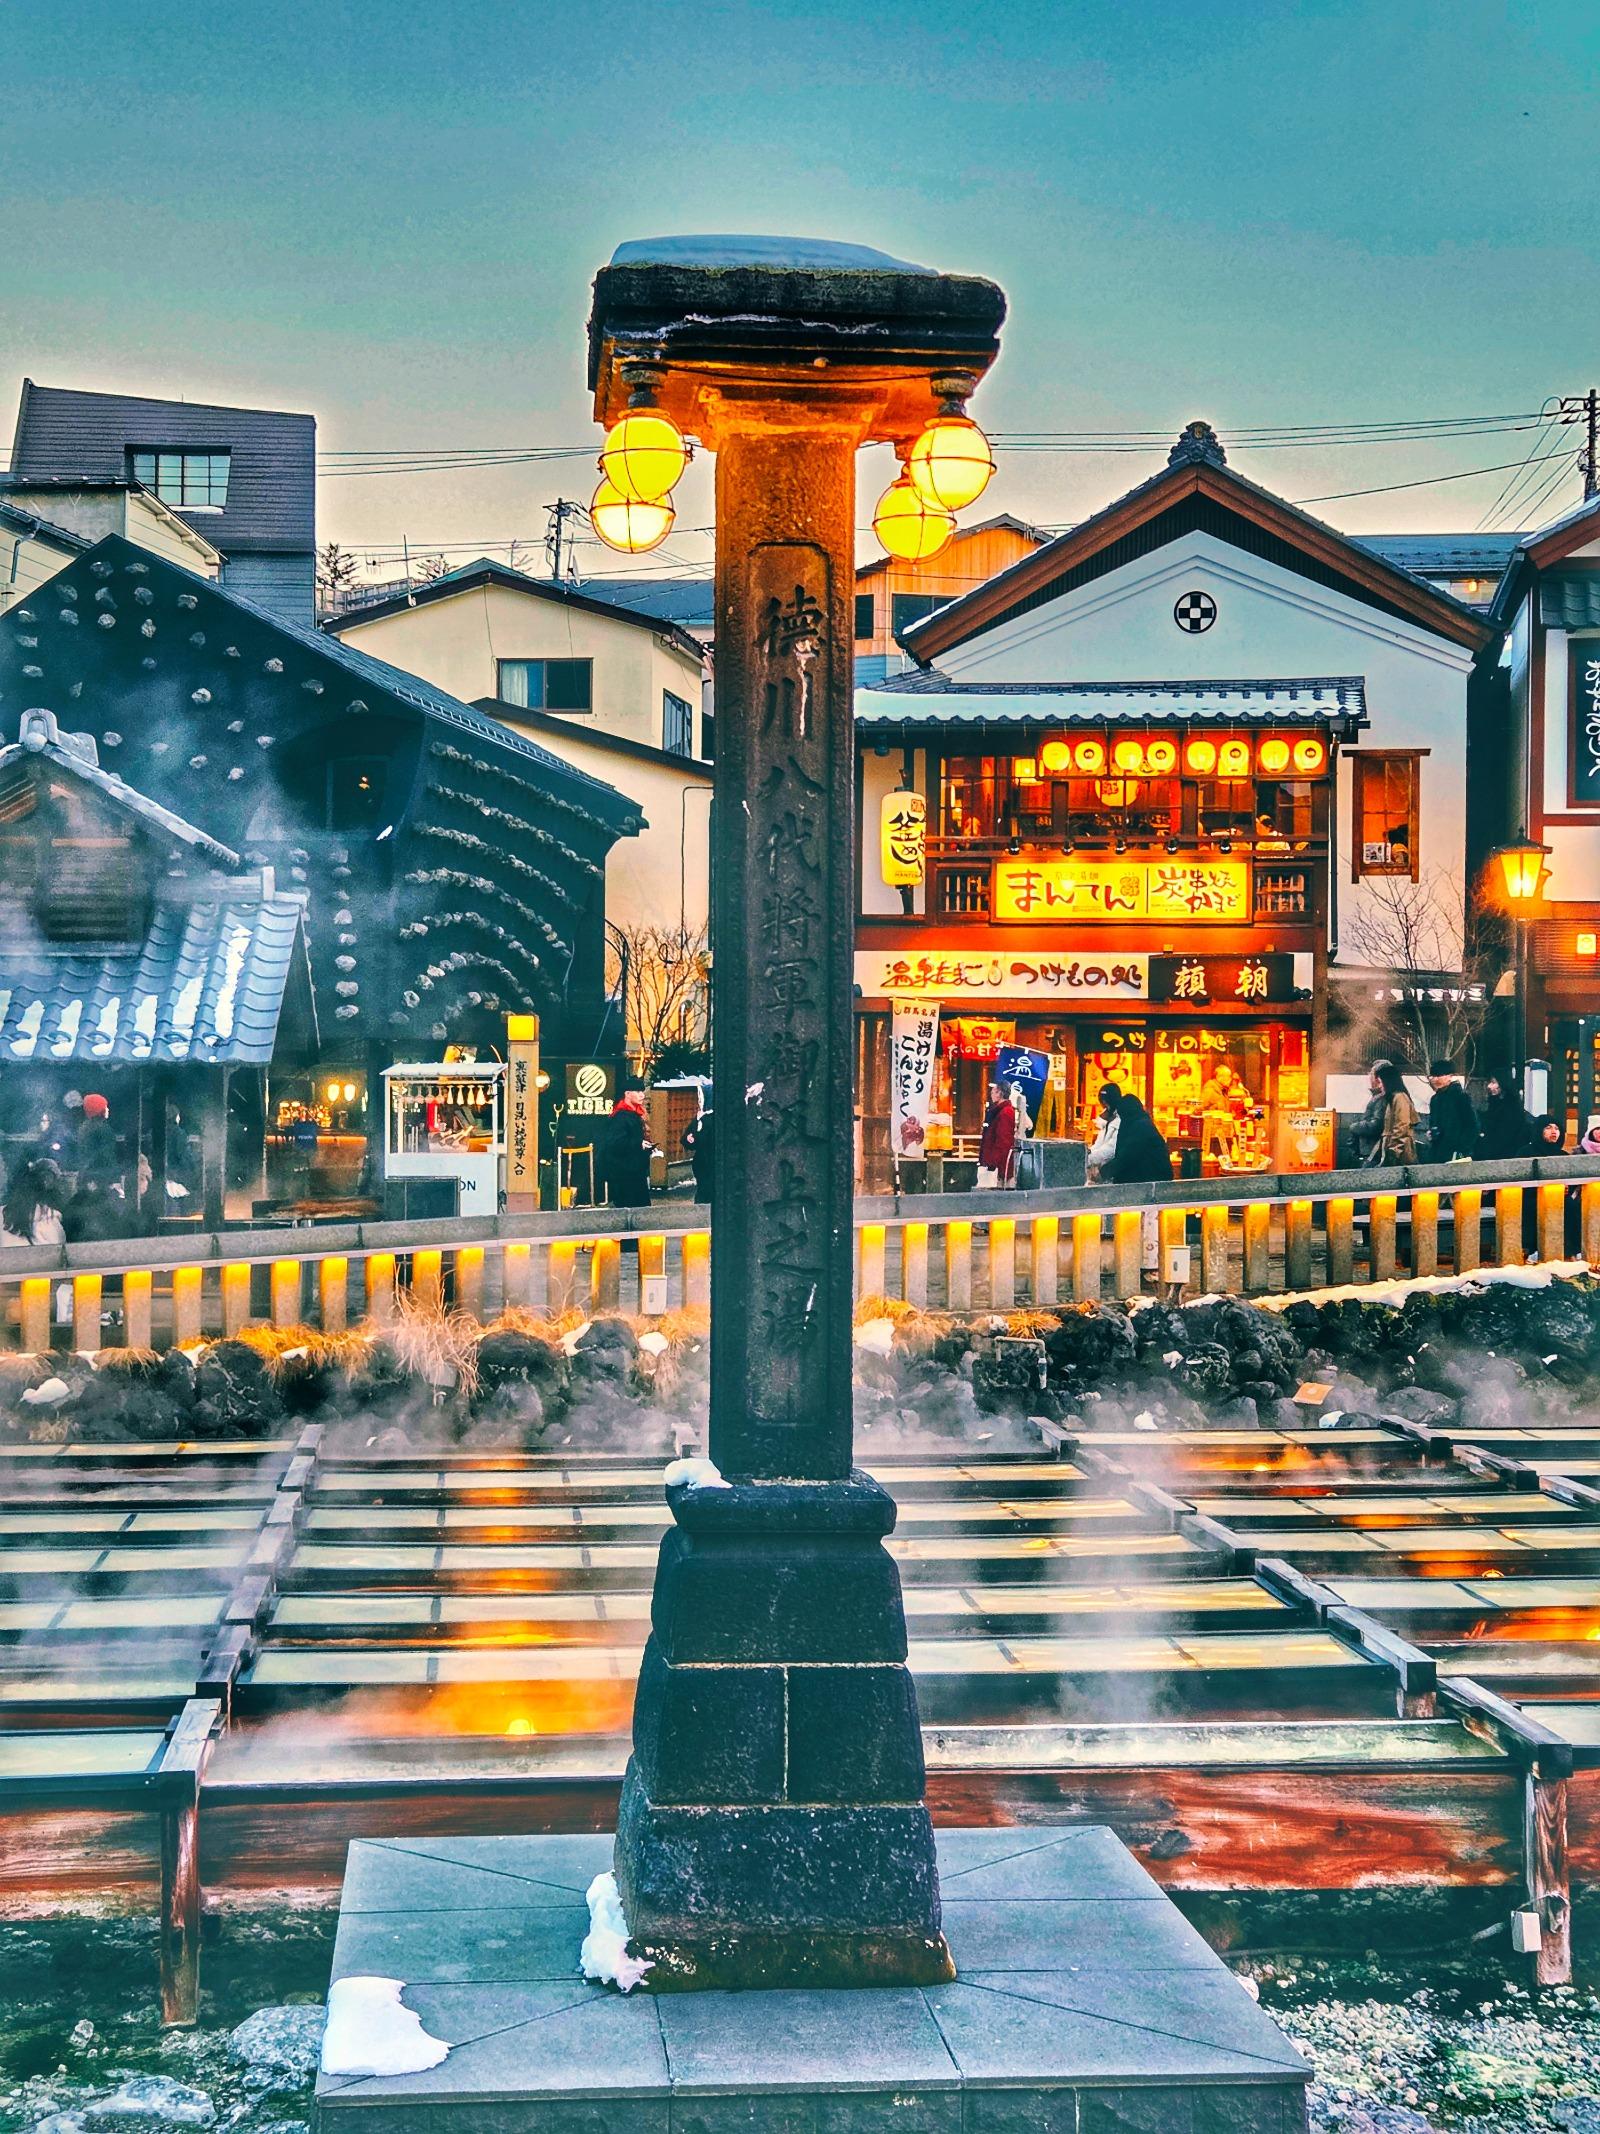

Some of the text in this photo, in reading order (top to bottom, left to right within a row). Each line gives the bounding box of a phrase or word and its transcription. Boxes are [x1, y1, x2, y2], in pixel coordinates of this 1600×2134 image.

[889, 811, 919, 864] 釜めし
[1006, 869, 1136, 912] まんてん
[1185, 892, 1241, 913] かまど
[880, 957, 984, 988] 温泉たまご
[1010, 962, 1142, 989] つけもの処
[914, 1021, 933, 1093] 湯けむり
[1103, 1029, 1227, 1051] つけもの処
[900, 1035, 916, 1117] こんにゃく
